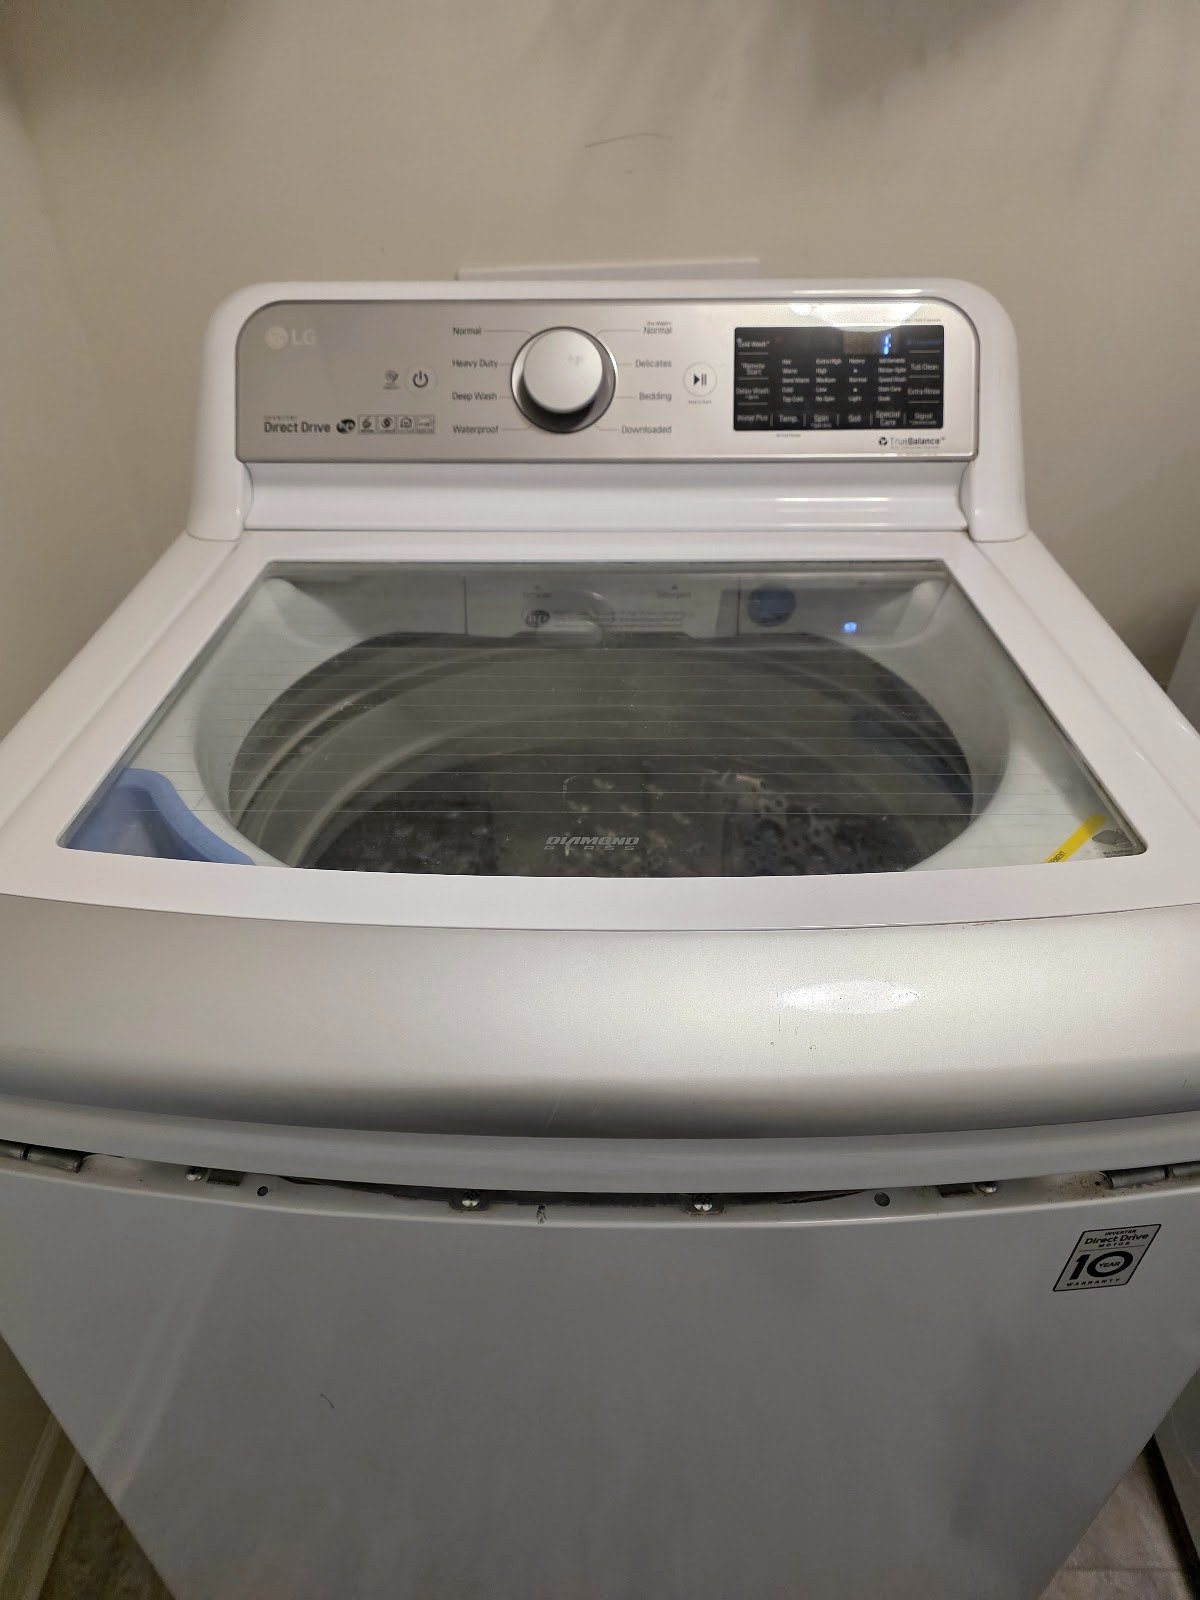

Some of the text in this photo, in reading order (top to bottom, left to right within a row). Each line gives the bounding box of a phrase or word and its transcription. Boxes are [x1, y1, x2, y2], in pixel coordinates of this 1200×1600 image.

[453, 326, 482, 336] Normal
[643, 325, 673, 335] Normal
[452, 359, 498, 369] Heavy Duty
[635, 359, 673, 368] Delicates
[452, 391, 498, 401] Deep Wash
[639, 392, 672, 402] Bedding
[264, 421, 331, 433] Direct Drive
[452, 424, 499, 434] Waterproof
[621, 424, 673, 434] Downloaded
[545, 836, 640, 845] DIAMOND
[1084, 1233, 1150, 1245] Direct Drive
[1069, 1250, 1134, 1280] 10
[1066, 1278, 1121, 1287] WARRANTY
